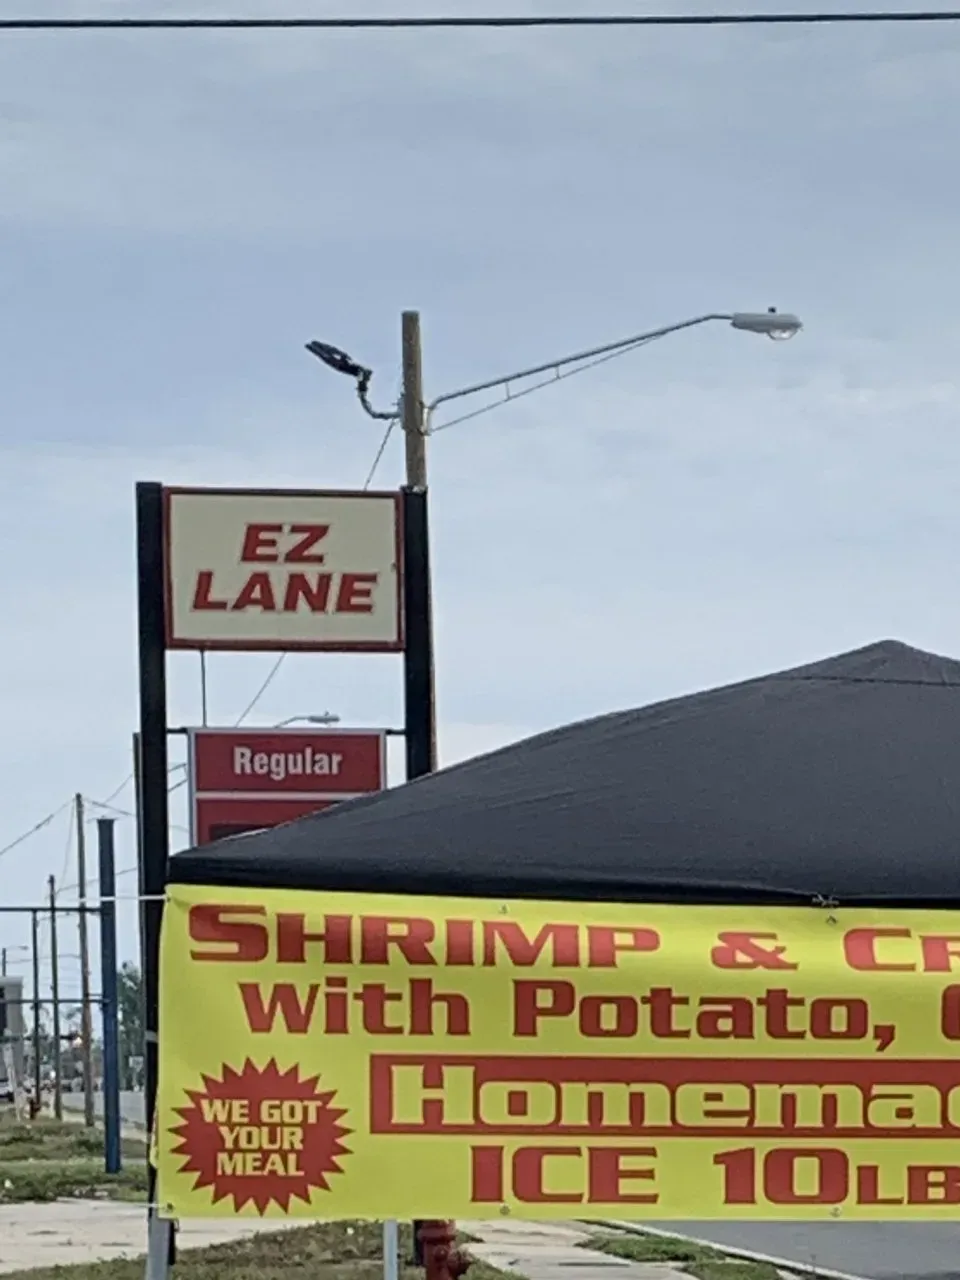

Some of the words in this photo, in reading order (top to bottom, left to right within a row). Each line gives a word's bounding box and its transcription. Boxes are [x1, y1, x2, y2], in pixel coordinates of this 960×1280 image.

[240, 523, 330, 563] EZ
[190, 571, 378, 613] LANE
[233, 746, 343, 781] Regular
[188, 904, 661, 968] SHRIMP
[711, 931, 799, 971] &
[238, 977, 470, 1036] With
[512, 979, 895, 1051] Potato,
[200, 1099, 249, 1123] WE
[260, 1100, 323, 1124] GOT
[218, 1126, 304, 1150] YOUR
[217, 1152, 304, 1176] MEAL
[470, 1145, 659, 1205] ICE
